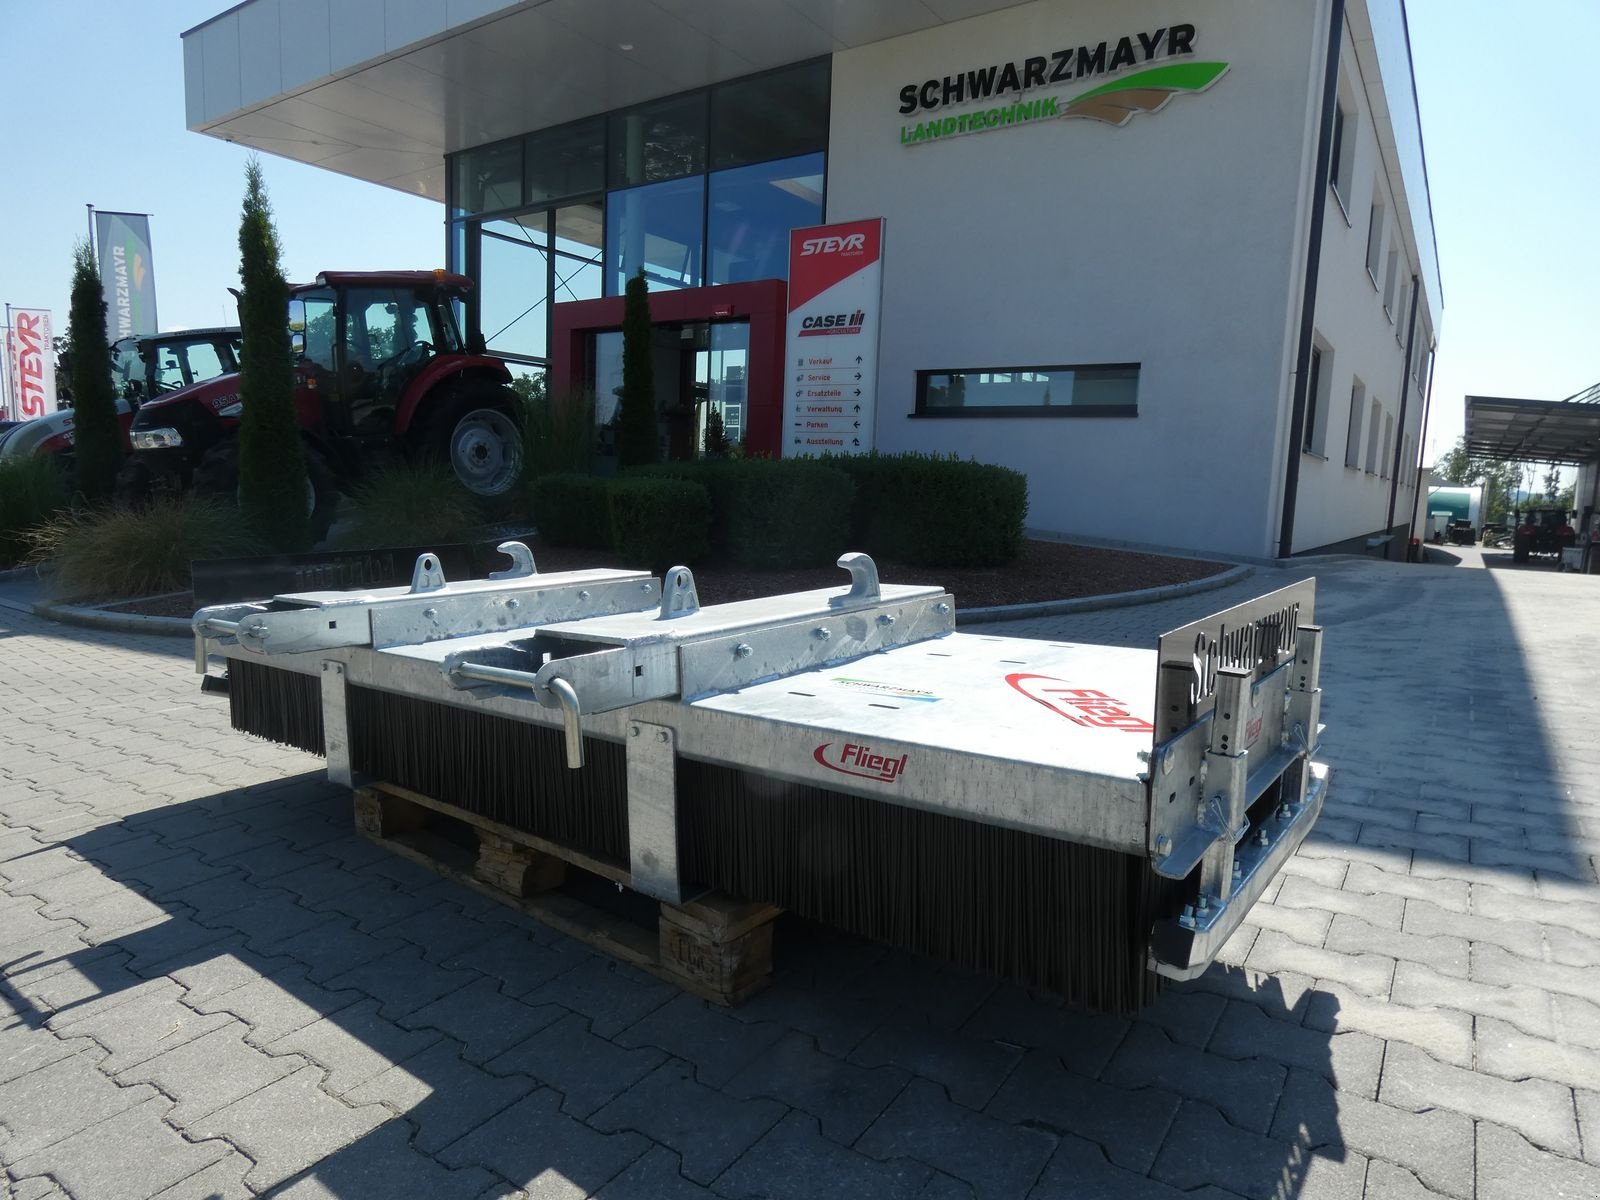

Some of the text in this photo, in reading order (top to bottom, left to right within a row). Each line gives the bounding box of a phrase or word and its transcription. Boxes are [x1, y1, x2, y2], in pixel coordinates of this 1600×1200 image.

[899, 23, 1197, 115] SCHWARZMAYR
[900, 96, 1060, 144] LANDTECHNIK
[800, 234, 865, 256] STEYR
[113, 245, 132, 338] HWARZMAYR
[802, 315, 846, 329] CASE
[17, 312, 45, 417] STEYR
[806, 438, 844, 446] Ausstellung
[840, 743, 908, 778] Fliegl
